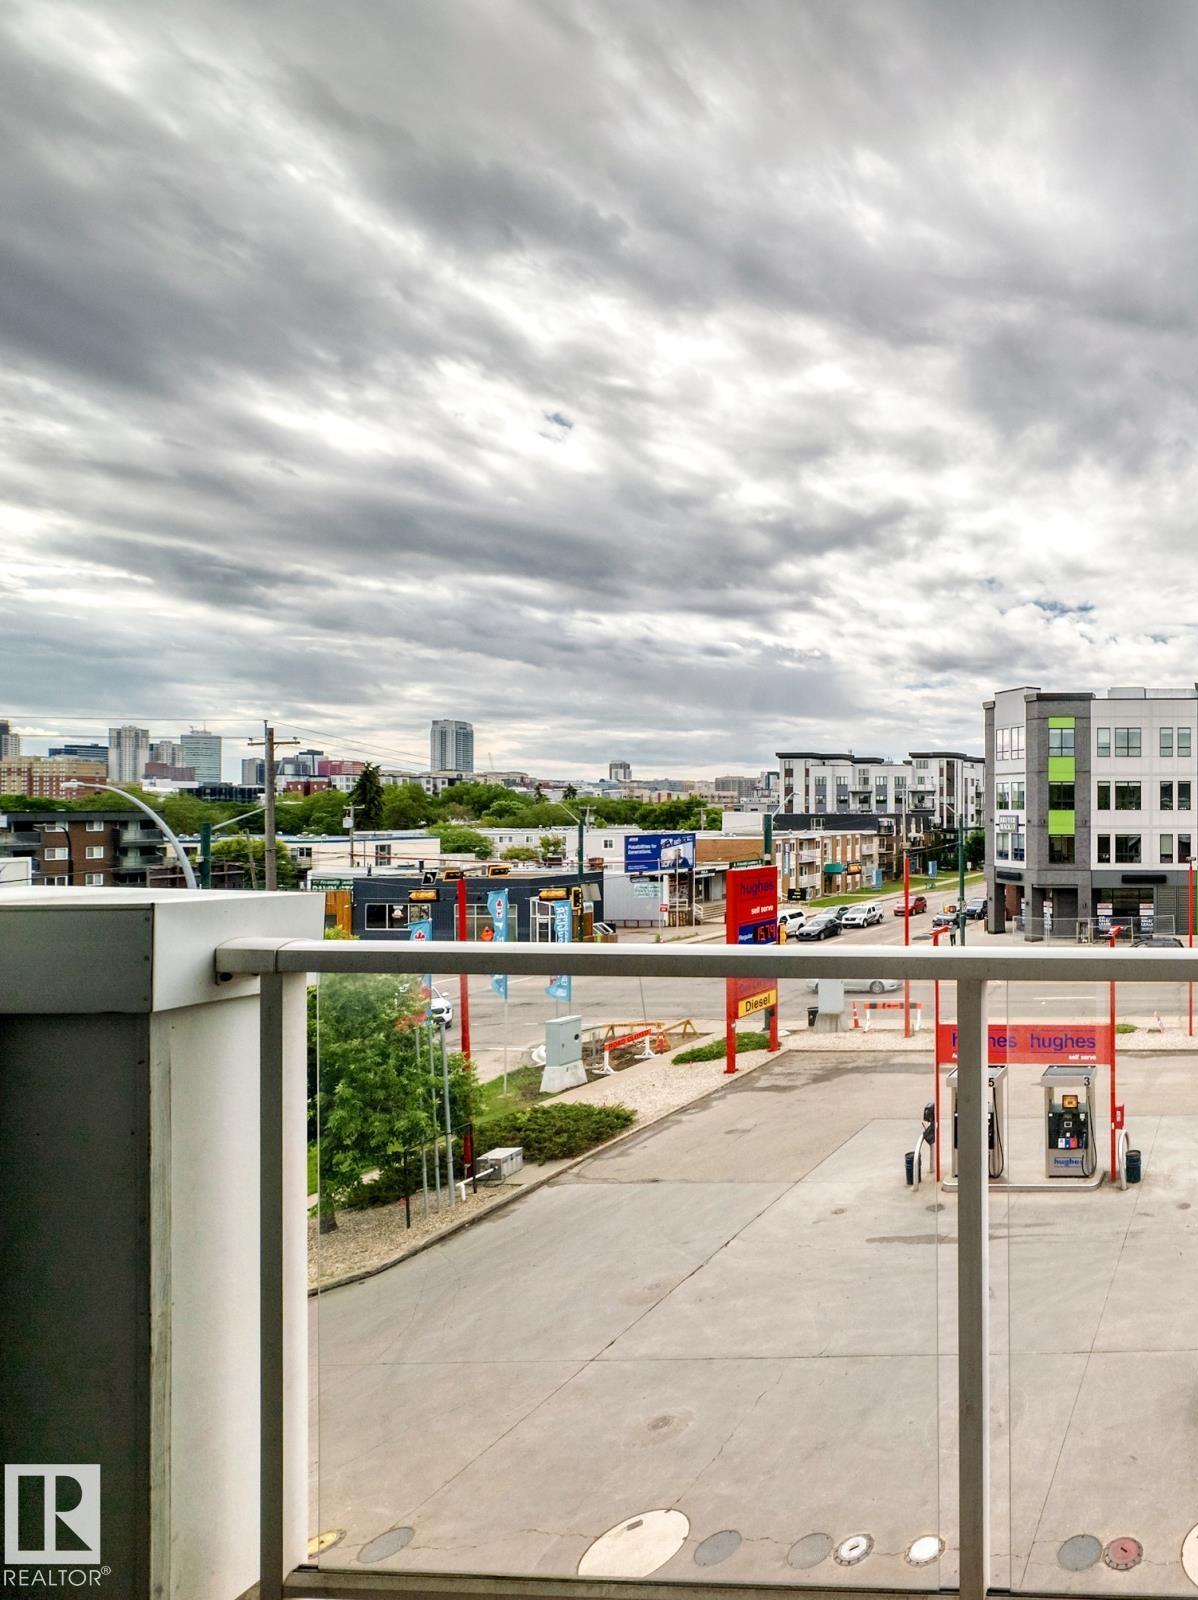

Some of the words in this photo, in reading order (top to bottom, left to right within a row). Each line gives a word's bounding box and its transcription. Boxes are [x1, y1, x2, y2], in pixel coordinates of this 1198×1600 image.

[739, 880, 775, 897] hughes
[751, 906, 760, 915] self
[761, 905, 774, 913] serve
[745, 993, 771, 1012] Diesel
[1030, 1033, 1096, 1051] hughes
[988, 1077, 995, 1087] 5
[1083, 1076, 1090, 1087] 3
